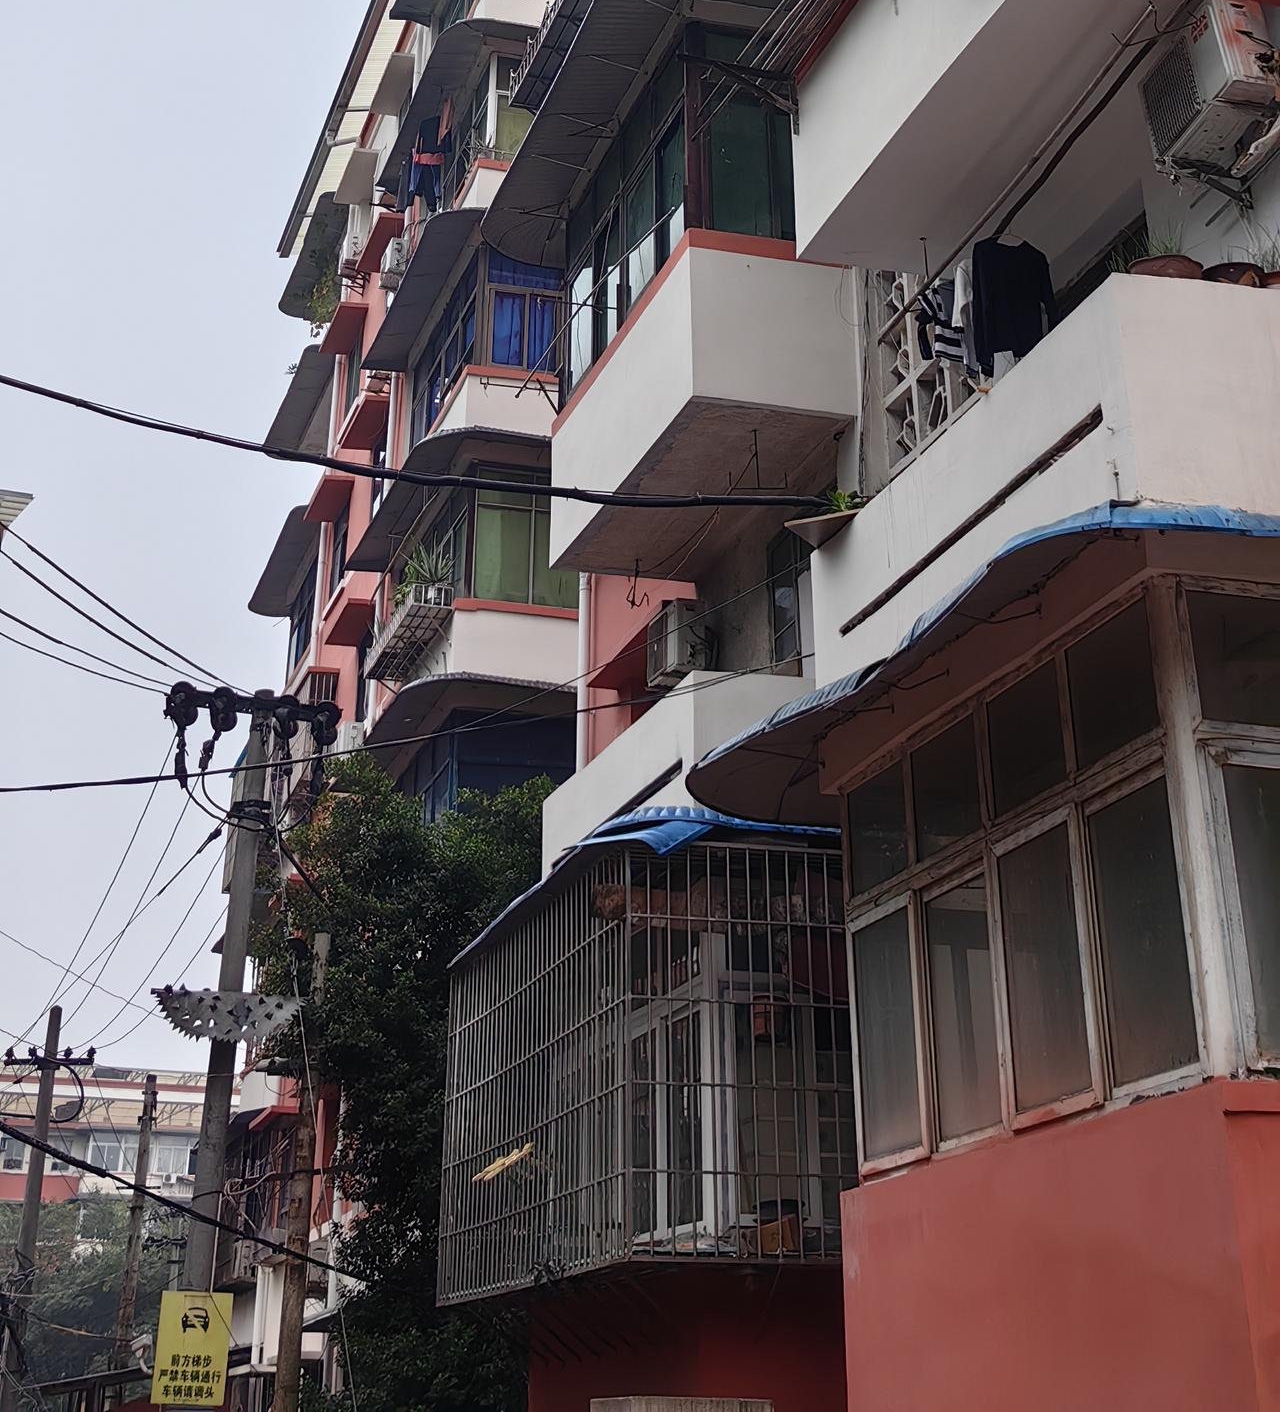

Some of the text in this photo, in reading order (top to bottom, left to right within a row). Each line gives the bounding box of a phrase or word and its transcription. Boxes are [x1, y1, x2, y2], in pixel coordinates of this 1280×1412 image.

[171, 1354, 212, 1368] 前方梯步
[158, 1369, 222, 1384] 严禁车辆通行
[162, 1384, 215, 1399] 车辆请调头
